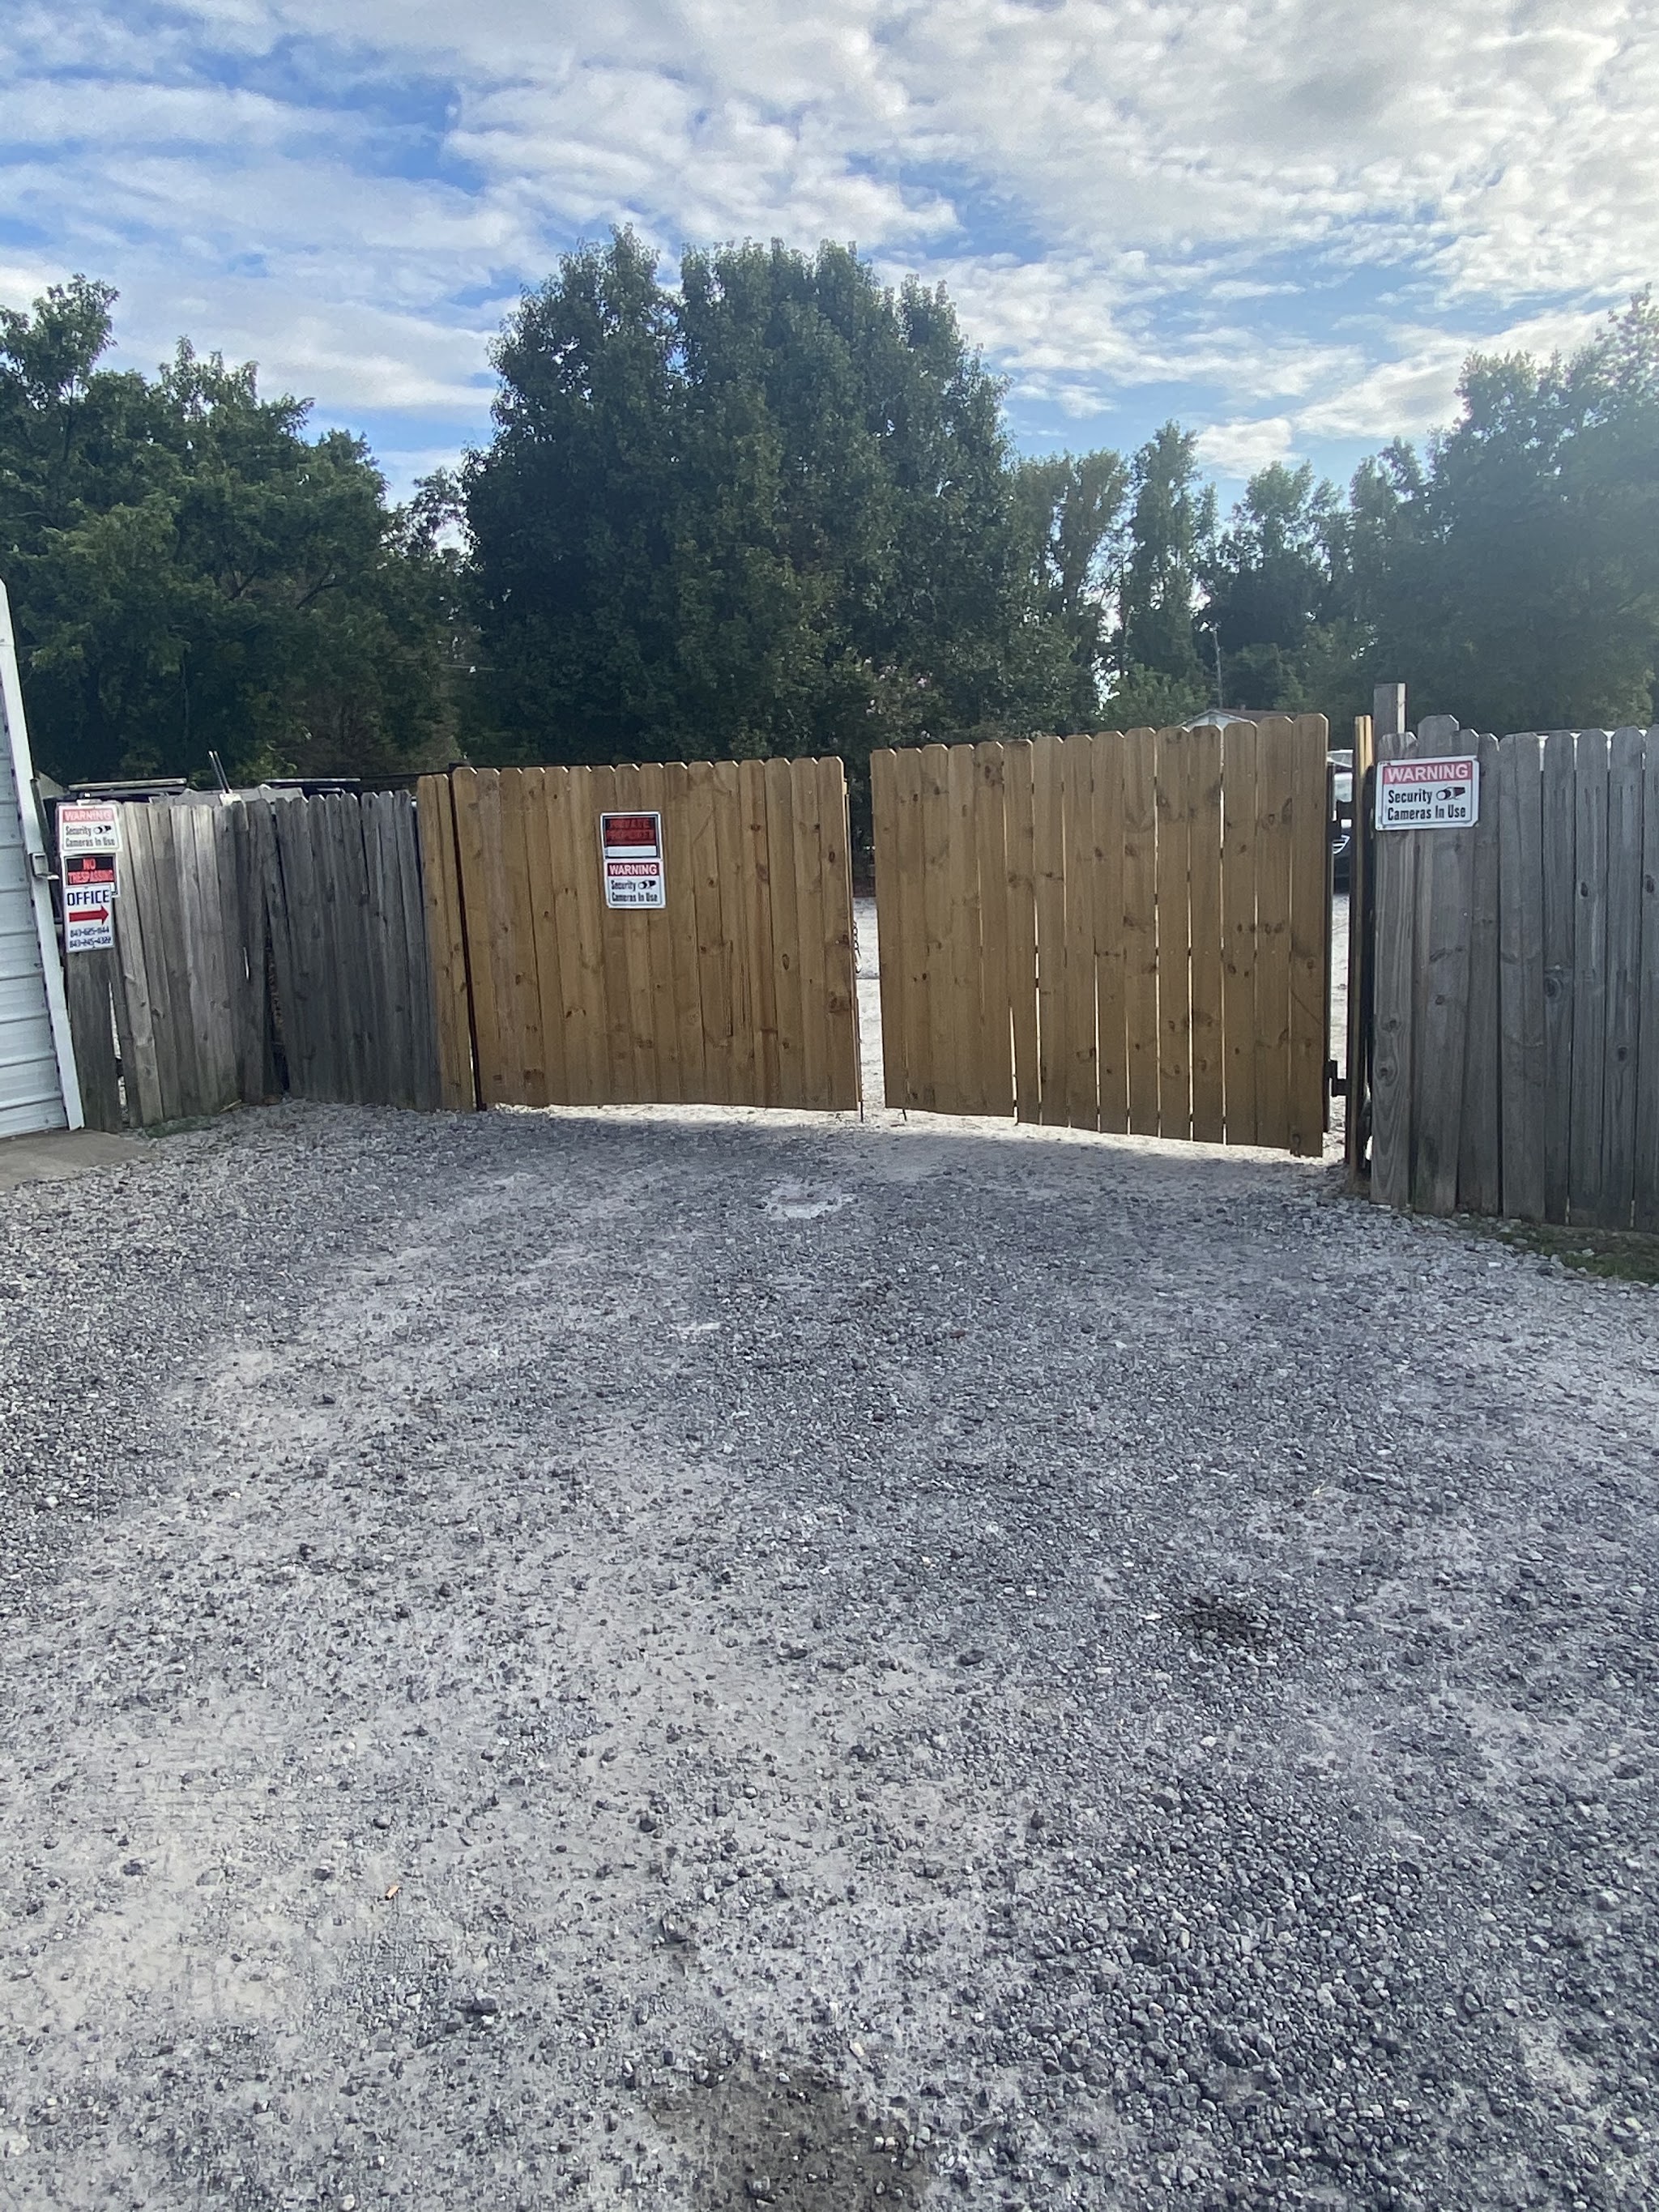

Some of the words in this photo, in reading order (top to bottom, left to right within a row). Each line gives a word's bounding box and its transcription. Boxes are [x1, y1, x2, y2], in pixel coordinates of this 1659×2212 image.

[1387, 764, 1468, 782] WARNING
[1388, 788, 1432, 804] Security
[65, 809, 112, 821] WARNING
[1388, 808, 1431, 821] Cameras
[1435, 805, 1444, 819] In
[1448, 804, 1466, 819] Use
[66, 825, 92, 837] Security
[66, 837, 94, 848] Cameras
[95, 837, 102, 846] In
[103, 837, 115, 846] Use
[83, 859, 96, 870] NO
[608, 863, 657, 876] WARNING
[68, 870, 114, 884] TRESPASSING
[611, 880, 636, 892] Security
[67, 890, 109, 906] OFFICE
[612, 892, 637, 902] Cameras
[638, 892, 645, 902] In
[646, 892, 658, 902] Use
